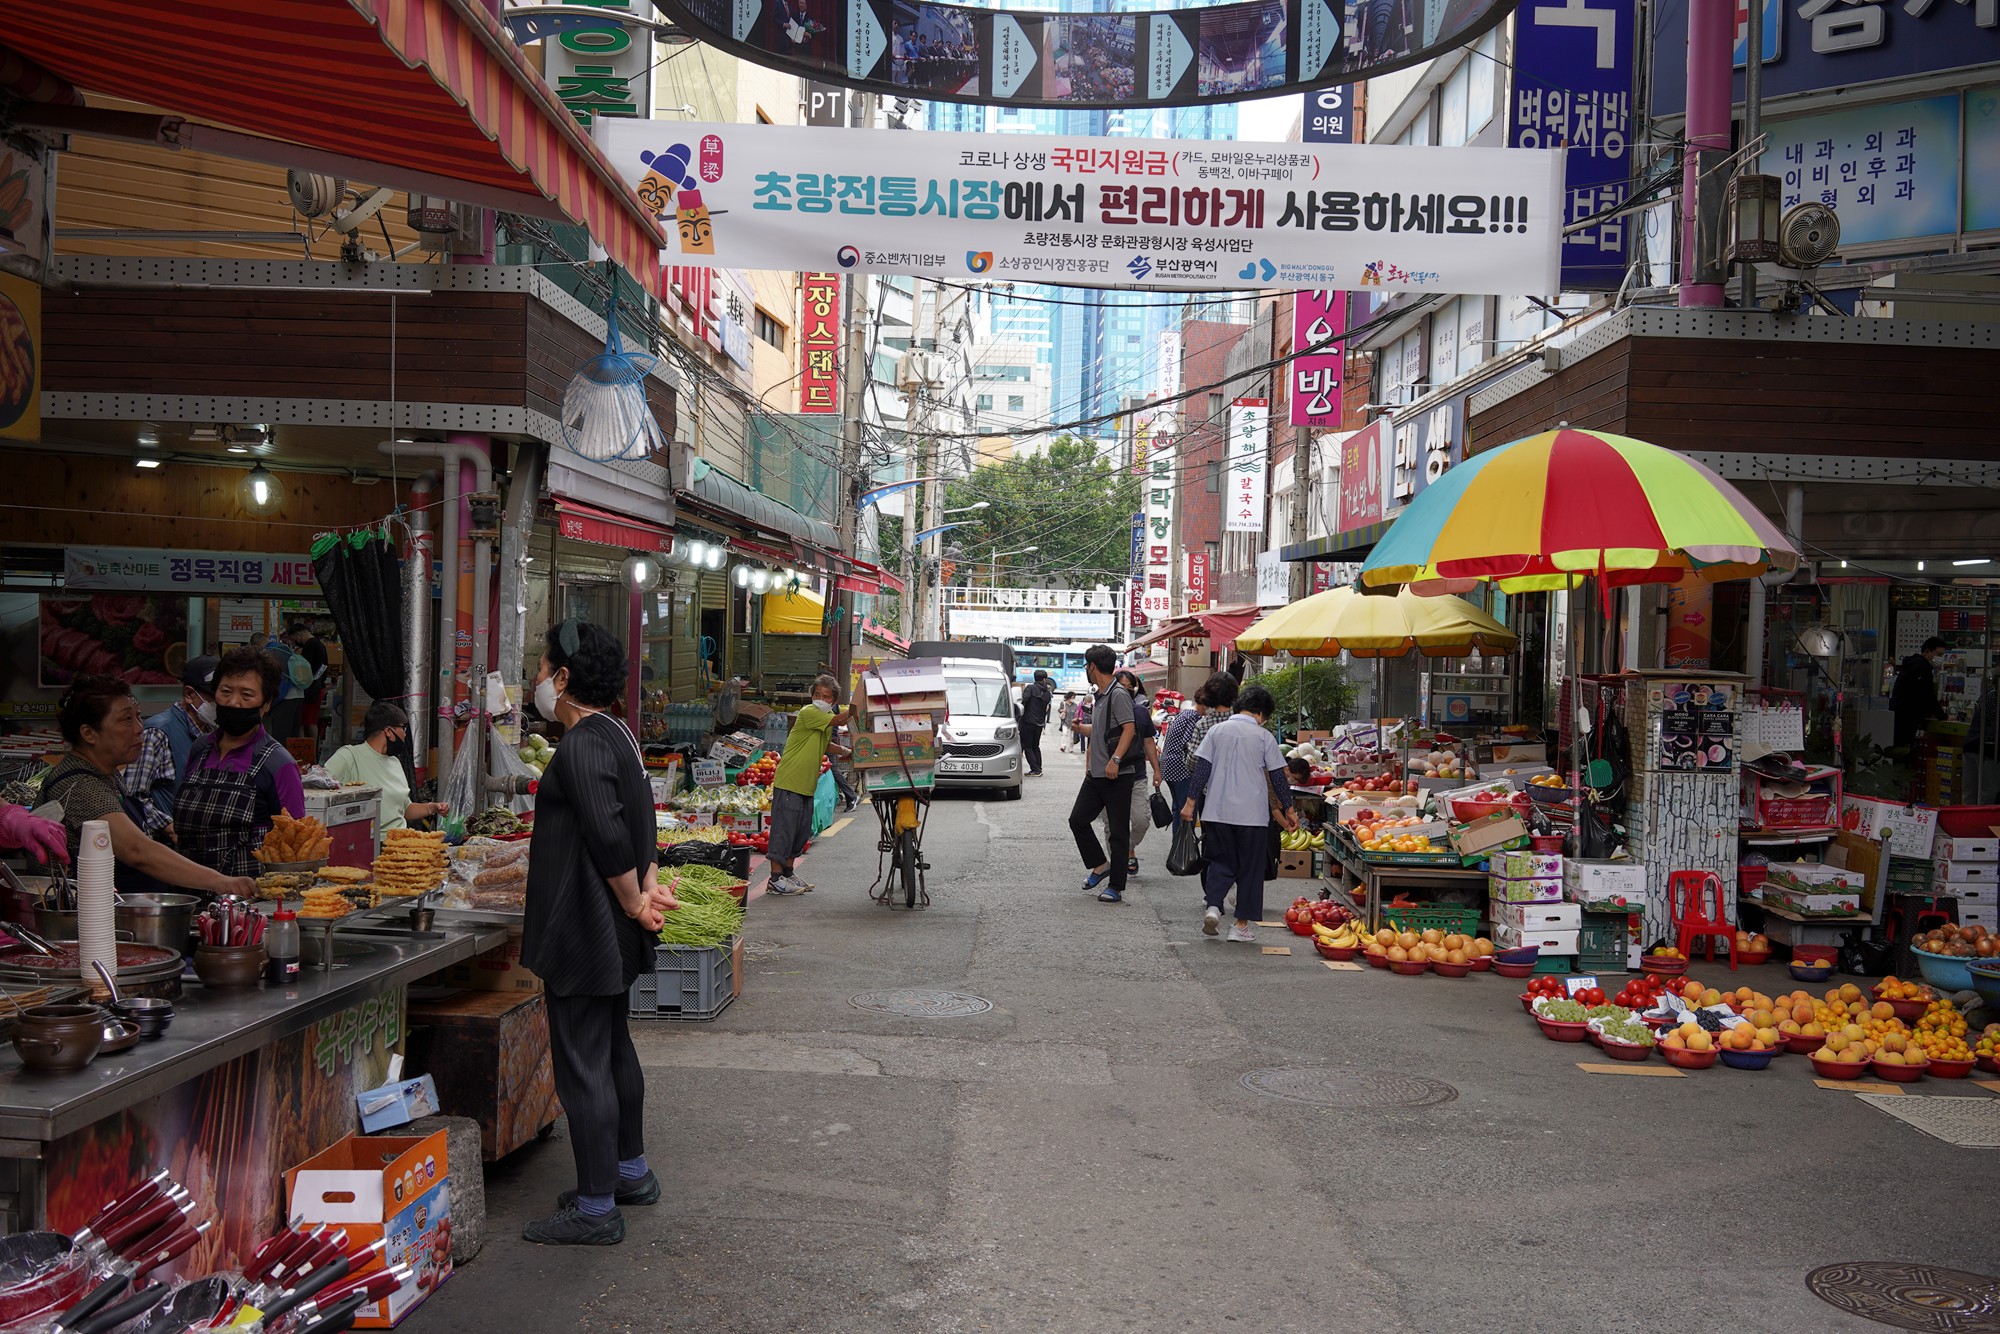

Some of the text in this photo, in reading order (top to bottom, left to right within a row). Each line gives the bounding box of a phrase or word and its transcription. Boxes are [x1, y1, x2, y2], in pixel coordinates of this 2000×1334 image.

[811, 92, 841, 118] PT
[1312, 116, 1343, 135] 의원
[1518, 88, 1628, 159] 병원처방
[959, 151, 1009, 169] 코로나
[1013, 151, 1046, 170] 상생
[1210, 152, 1310, 168] 모바일온누리상품권
[1237, 167, 1293, 181] 이바구페이
[753, 171, 1528, 234] 초량전통시장에서 편리하게 사용하세요!!!
[1564, 185, 1623, 252] 보험
[1023, 232, 1253, 253] 초량전통시장 문화관광형시장 육성사업단
[864, 251, 946, 267] 중소벤처기업부
[999, 256, 1109, 273] 소상공인시장진흥공단
[1155, 258, 1218, 273] 부산광역시
[1279, 271, 1335, 282] 부산광역시 동구
[1308, 418, 1326, 426] 지하
[1238, 477, 1253, 519] 칼국수
[1344, 477, 1367, 521] 가요방
[97, 562, 160, 576] 농축산마트
[169, 557, 263, 584] 정육직영
[1144, 597, 1170, 610] 화장품
[13, 702, 57, 714] 농축산마트
[960, 763, 979, 771] 4038
